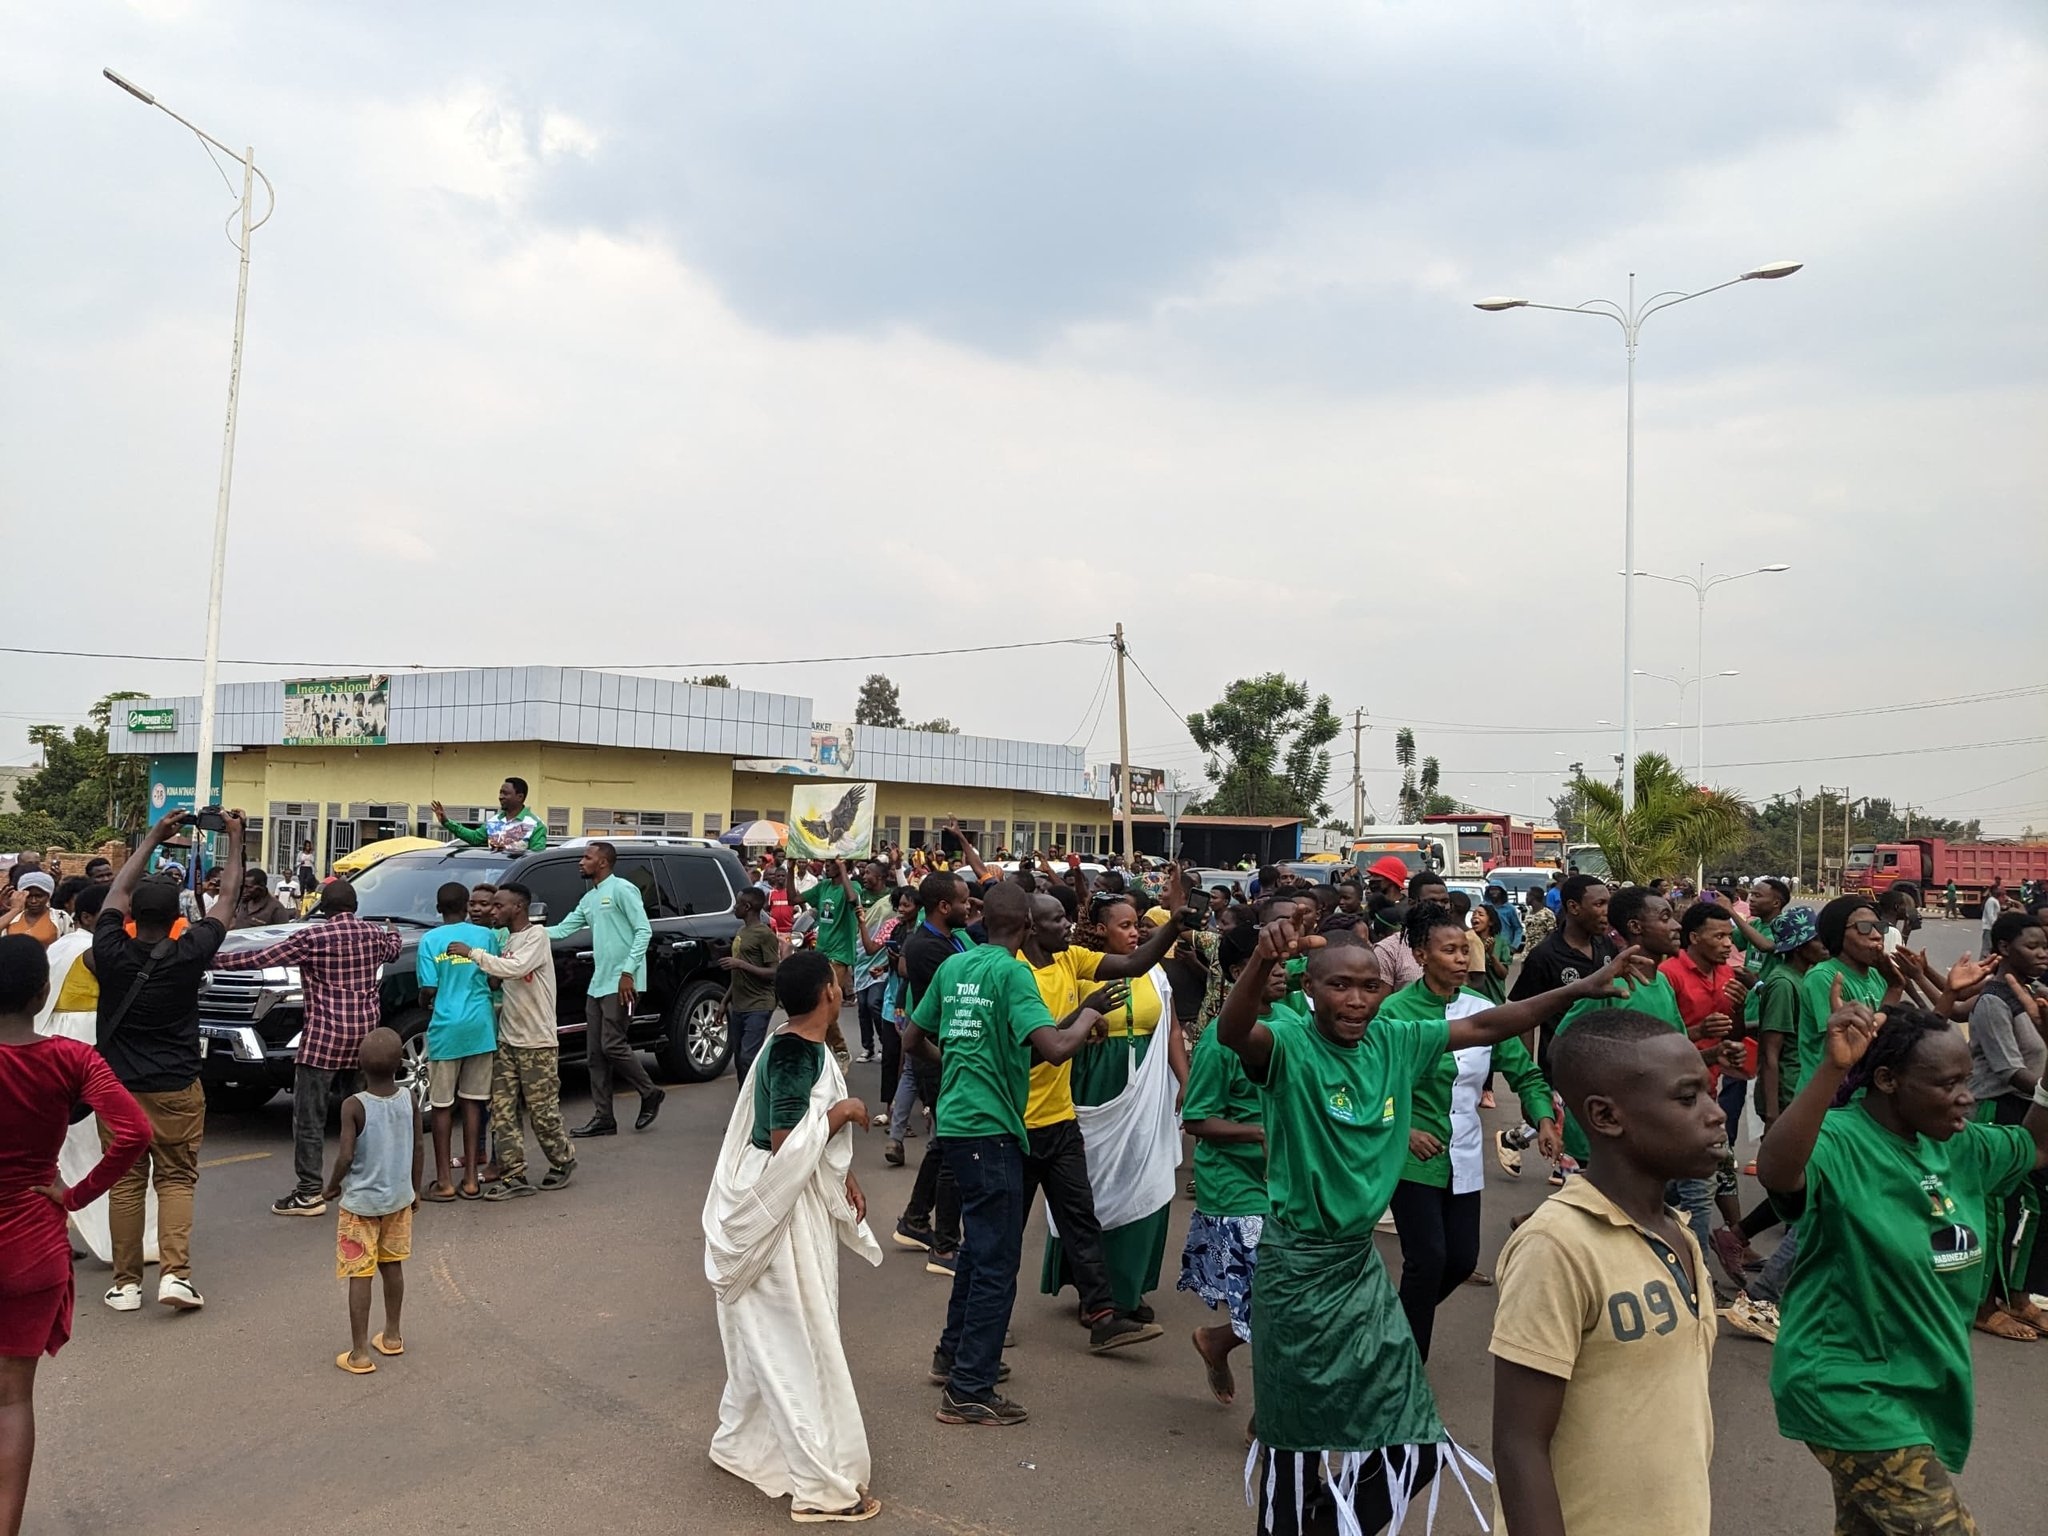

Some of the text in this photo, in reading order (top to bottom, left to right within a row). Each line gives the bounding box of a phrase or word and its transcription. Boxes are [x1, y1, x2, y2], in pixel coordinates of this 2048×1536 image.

[296, 682, 371, 694] Ineza Saloon
[811, 721, 832, 732] ARKET
[956, 983, 980, 996] TORA
[1608, 1280, 1678, 1342] 09
